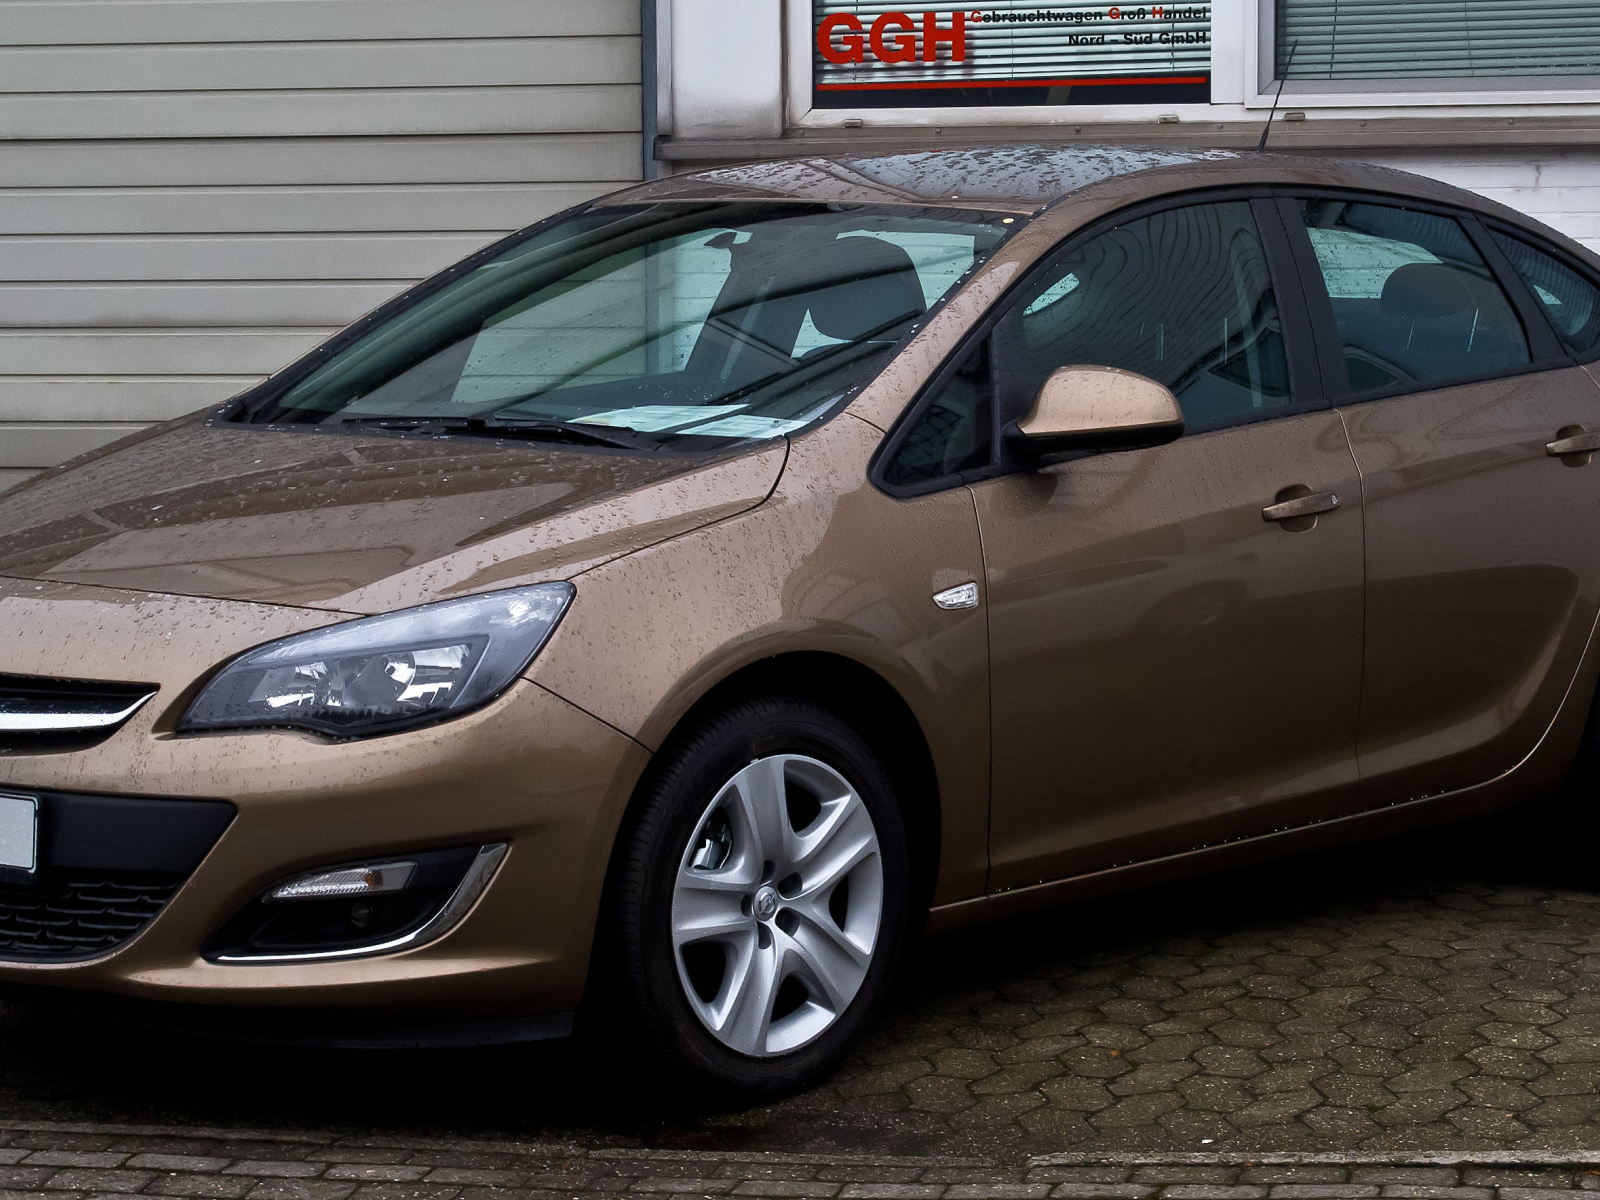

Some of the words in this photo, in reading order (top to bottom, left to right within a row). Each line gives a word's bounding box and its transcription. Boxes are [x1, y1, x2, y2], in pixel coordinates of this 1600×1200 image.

[970, 8, 1102, 24] Gebrauchtwagen
[1108, 6, 1146, 20] Groß
[1152, 6, 1207, 19] Handel
[816, 11, 966, 64] GGH
[1069, 32, 1105, 46] Nord
[1123, 31, 1153, 45] Süd
[1158, 31, 1207, 45] GmbH
